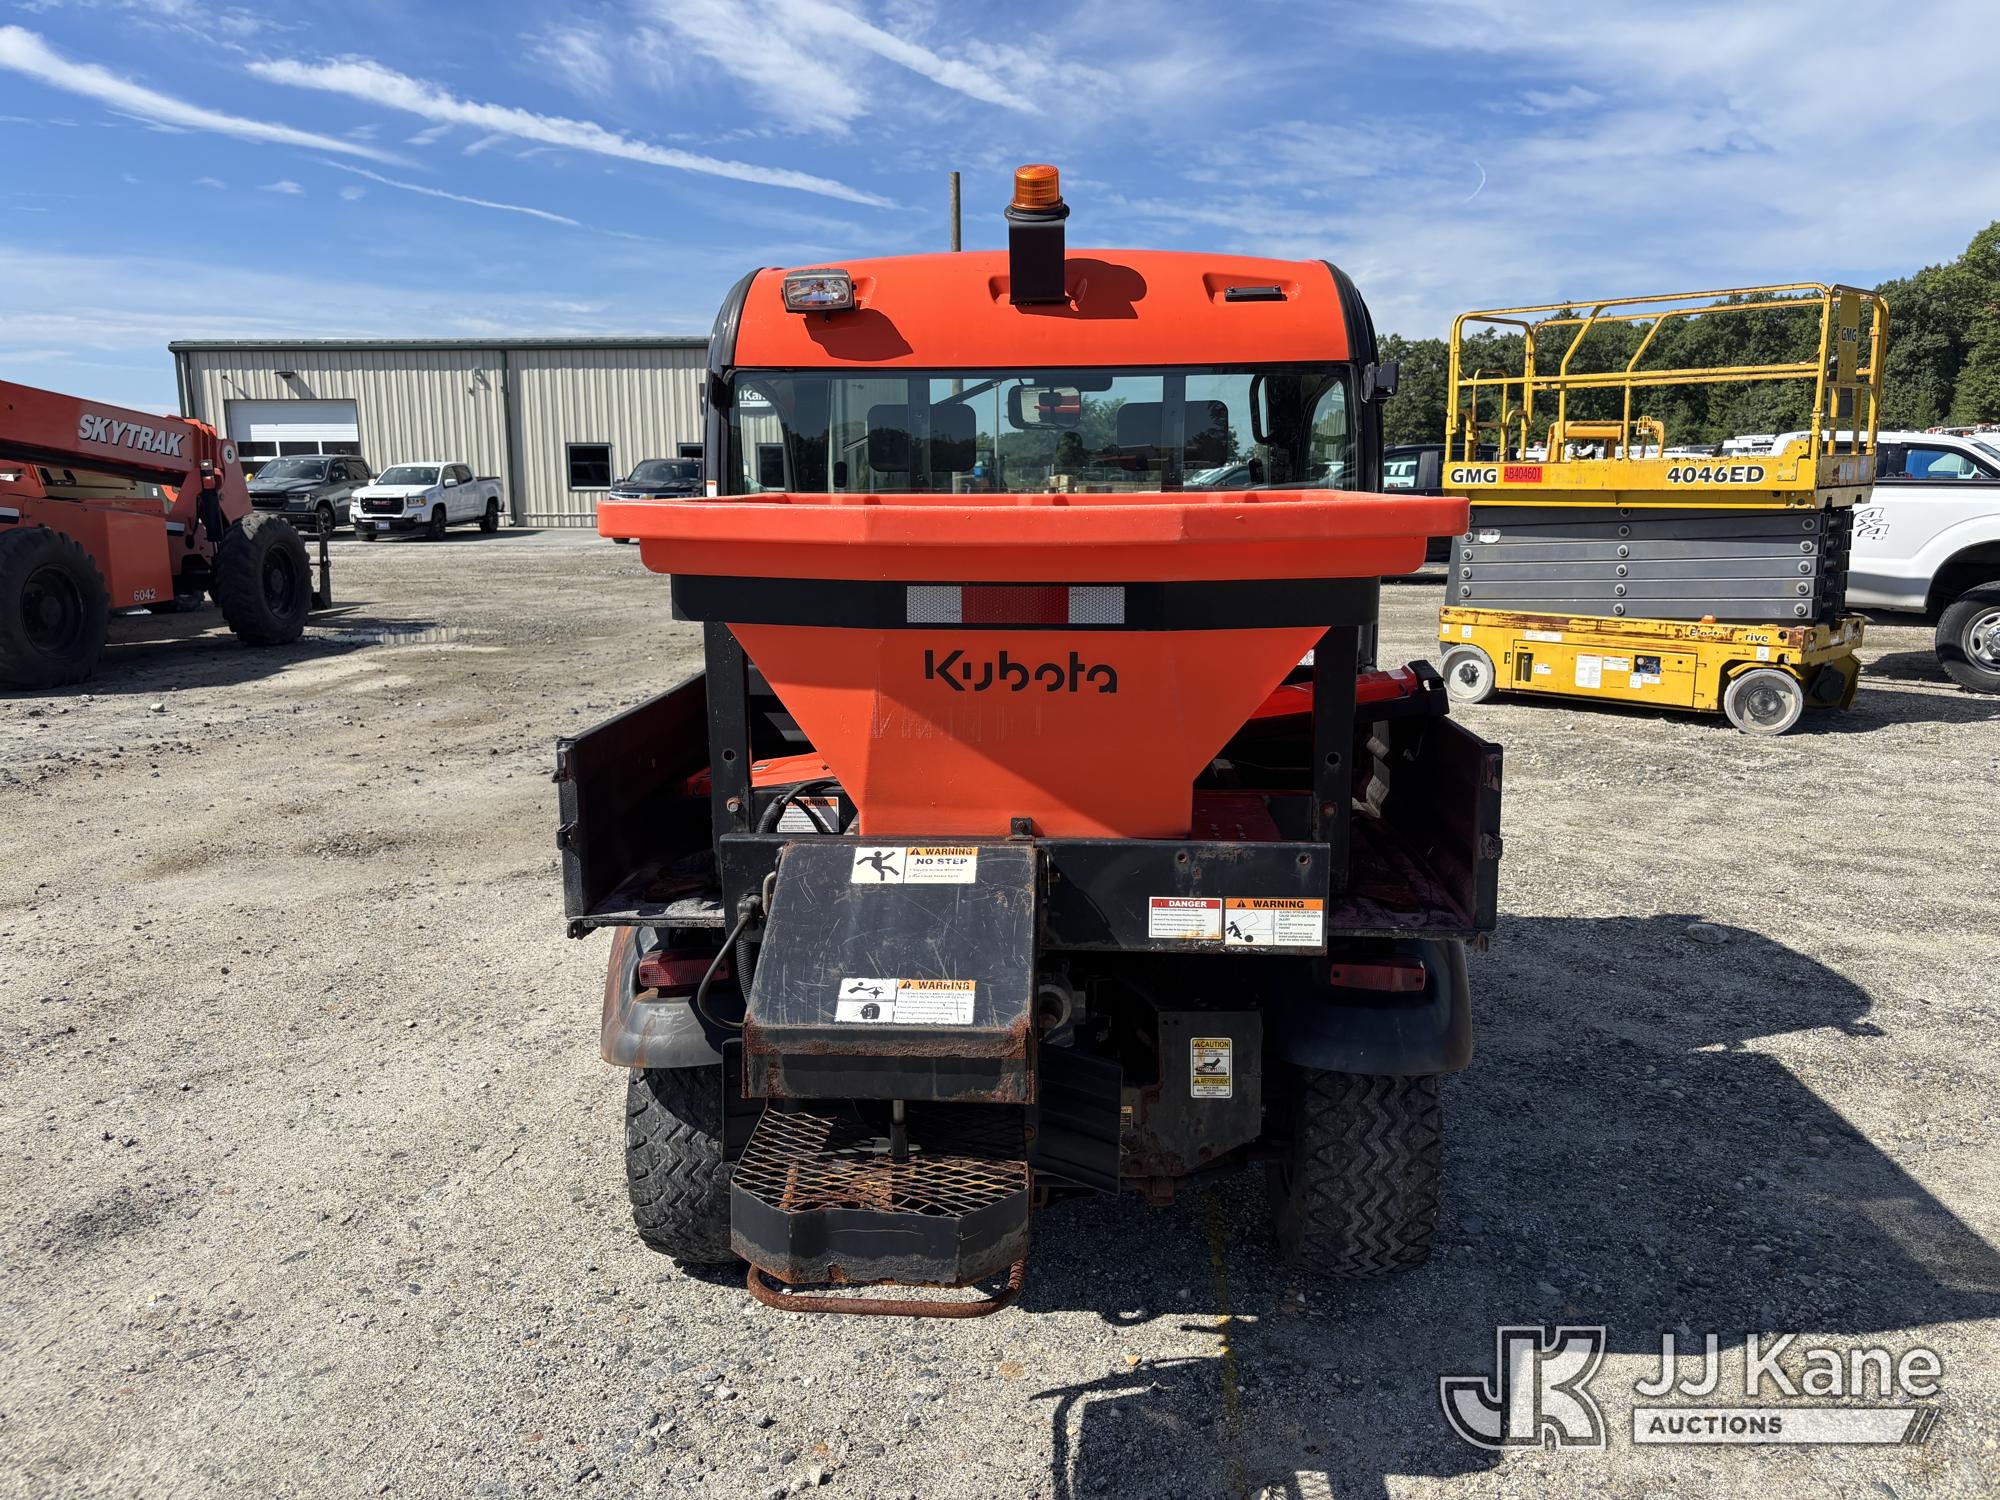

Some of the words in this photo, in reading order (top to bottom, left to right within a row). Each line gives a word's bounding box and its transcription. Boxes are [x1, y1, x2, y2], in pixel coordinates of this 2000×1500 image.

[78, 414, 185, 458] SKYTRAK
[226, 450, 233, 460] 6
[1450, 467, 1498, 484] GMG
[1666, 466, 1765, 484] 4046ED
[133, 588, 157, 601] 6042
[1743, 632, 1769, 643] rive
[924, 649, 1118, 693] Kubota
[925, 847, 973, 856] WARNING
[1168, 900, 1207, 908] DANGER
[1252, 900, 1304, 909] WARNING
[918, 980, 970, 991] WARNING
